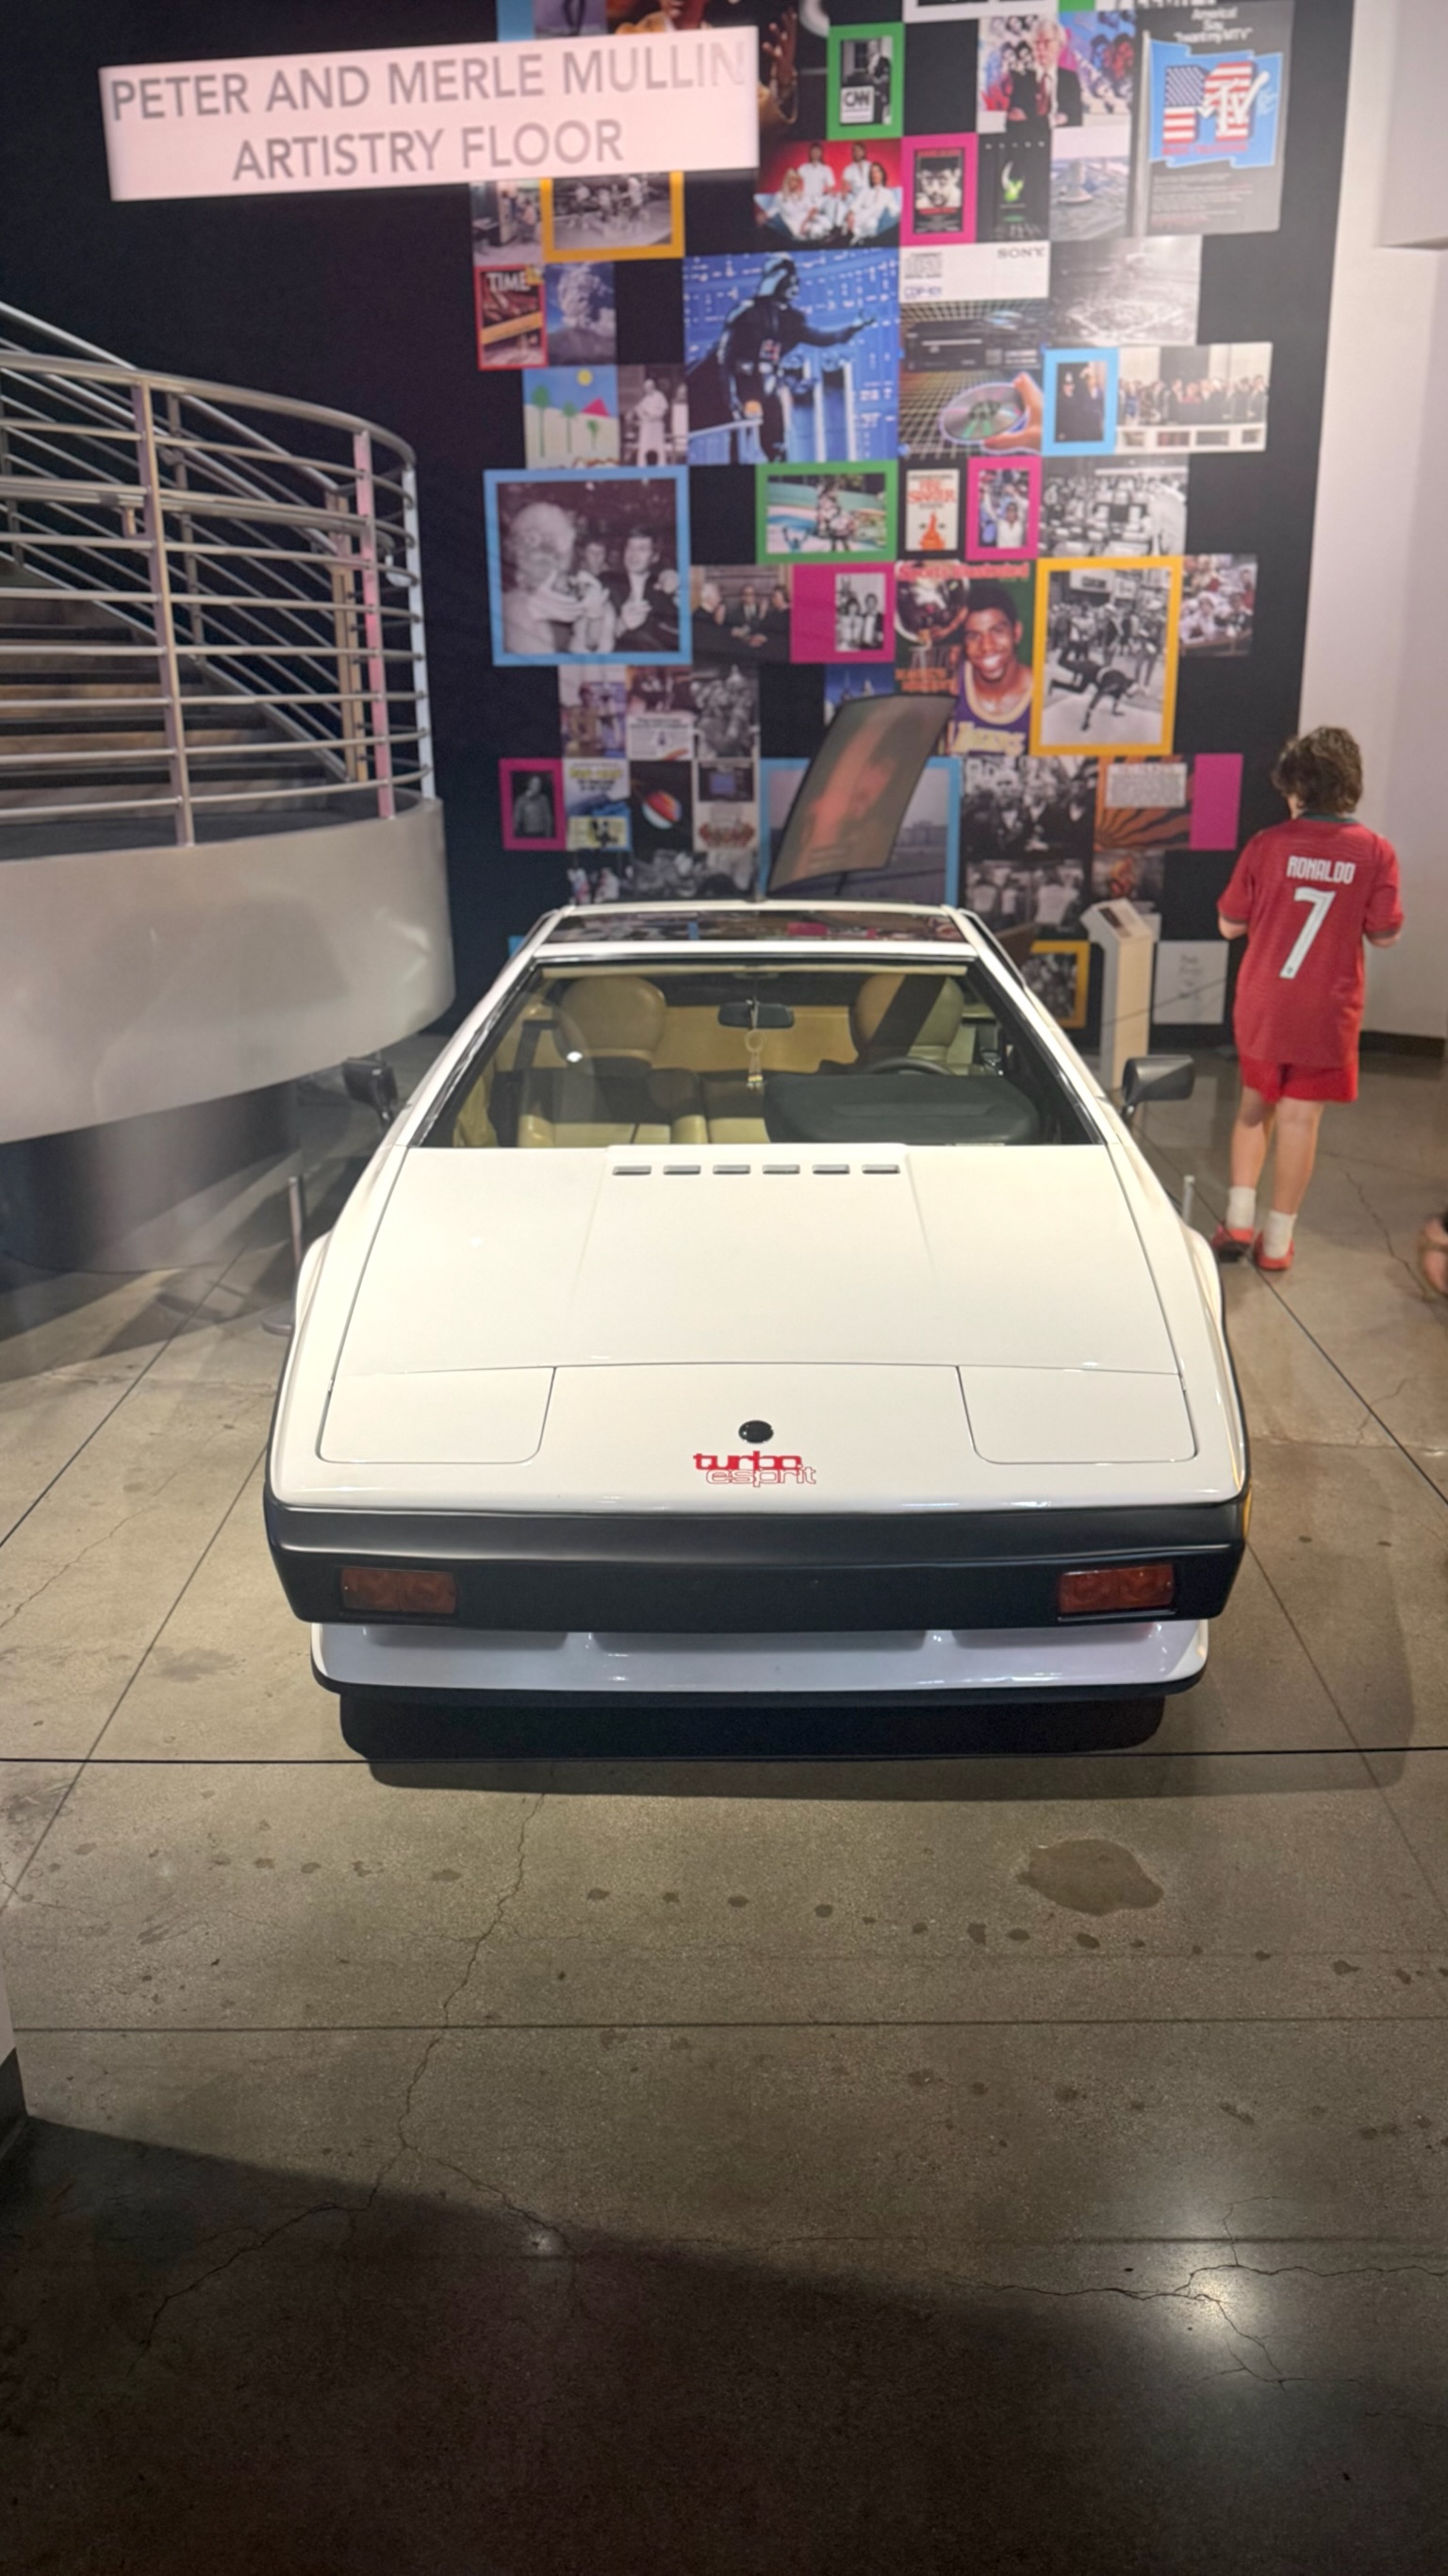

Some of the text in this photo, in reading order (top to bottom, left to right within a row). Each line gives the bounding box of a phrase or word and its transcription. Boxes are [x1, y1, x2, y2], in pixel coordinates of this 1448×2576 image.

[111, 40, 746, 122] PETER AND MERLE MULLIN
[232, 118, 625, 182] ARTISTRY FLOOR
[996, 247, 1046, 259] SONY
[485, 271, 532, 291] TIME
[1286, 855, 1357, 885] RONALDO
[1278, 886, 1337, 980] 7
[693, 1450, 803, 1471] turbo
[706, 1466, 816, 1487] esprit
